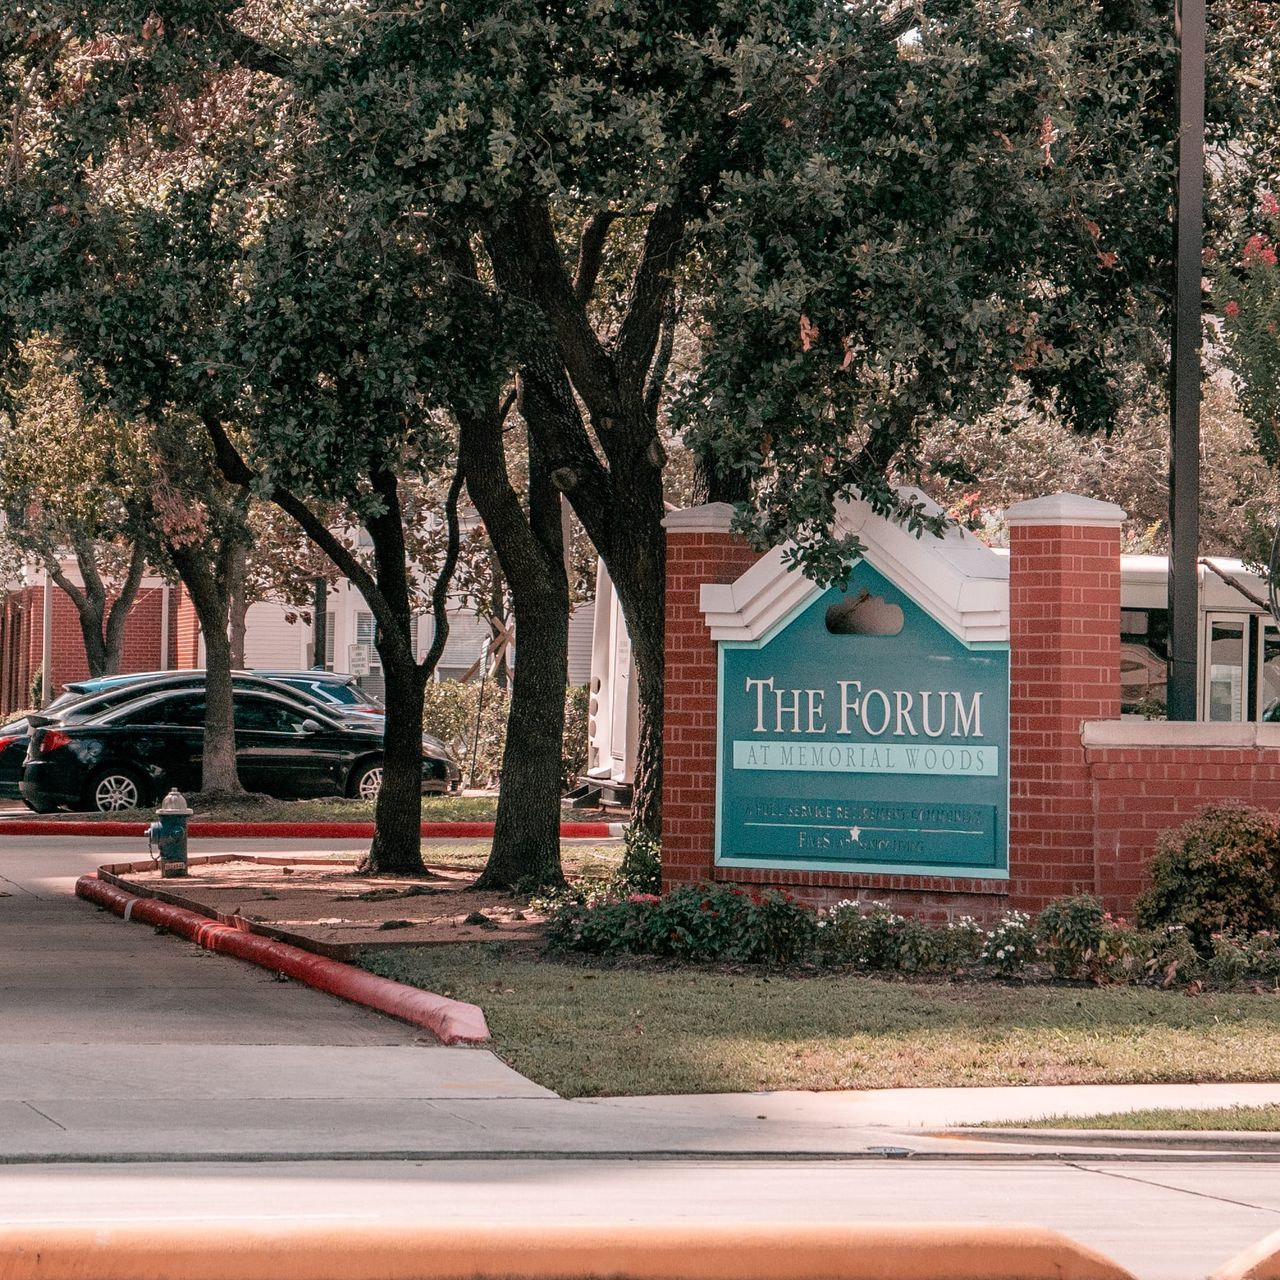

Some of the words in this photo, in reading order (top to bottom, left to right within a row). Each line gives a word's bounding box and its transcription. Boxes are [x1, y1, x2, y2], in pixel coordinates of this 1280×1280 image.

[746, 676, 826, 733] THE
[837, 680, 984, 737] FORUM
[747, 745, 770, 765] AT
[781, 745, 895, 768] MEMORIAL
[906, 748, 985, 770] WOODS
[788, 806, 832, 819] SERVICE
[836, 807, 906, 821] REREMENT
